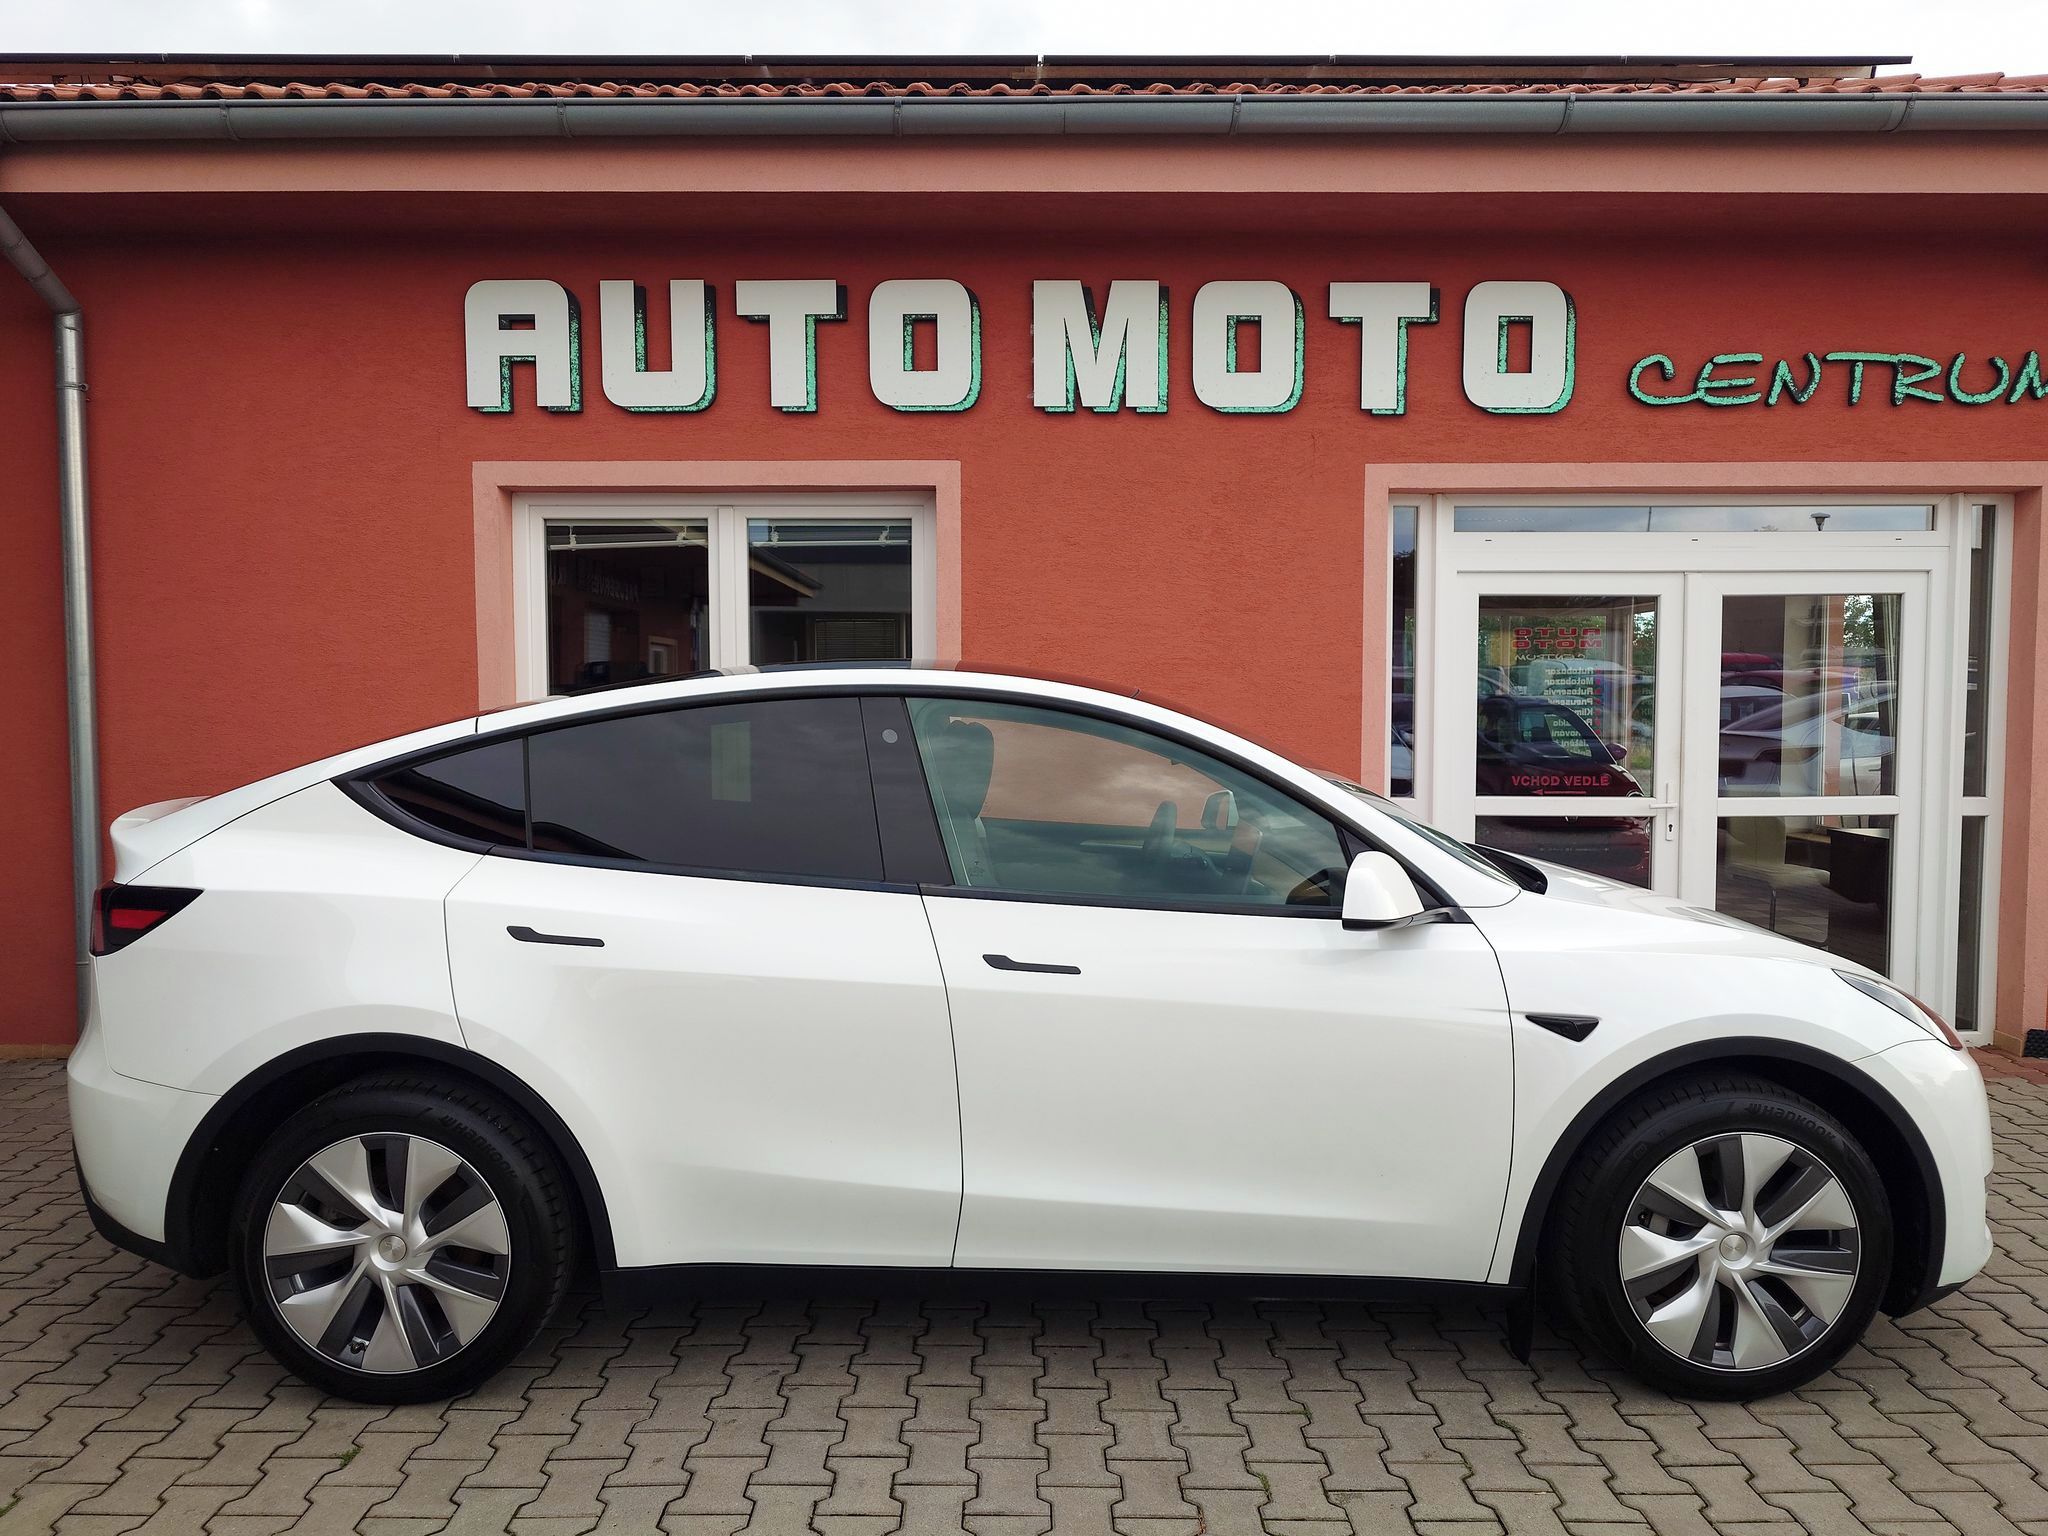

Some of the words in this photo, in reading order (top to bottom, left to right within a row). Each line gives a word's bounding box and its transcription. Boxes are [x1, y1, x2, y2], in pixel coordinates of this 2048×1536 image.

[464, 279, 981, 412] AUTO
[1033, 279, 1576, 413] MOTO
[1511, 775, 1560, 786] VCHOD
